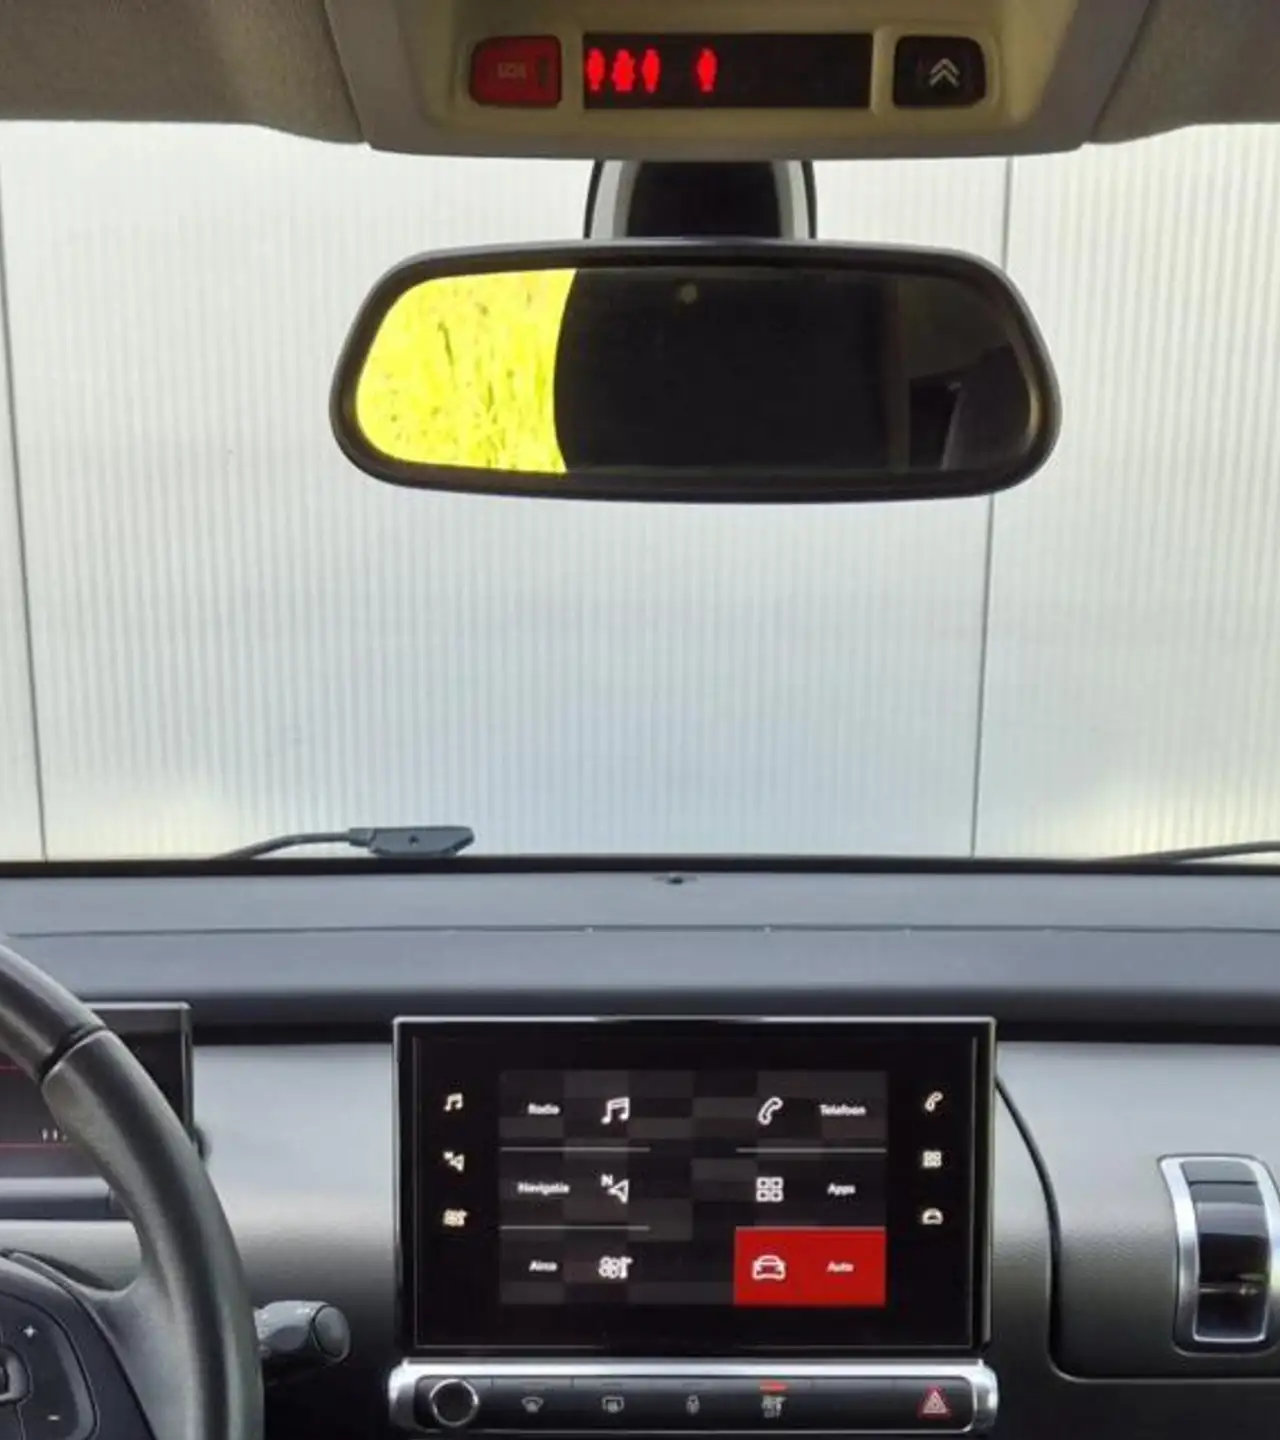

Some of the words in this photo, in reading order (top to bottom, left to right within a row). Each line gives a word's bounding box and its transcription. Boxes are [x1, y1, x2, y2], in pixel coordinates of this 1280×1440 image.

[820, 1104, 867, 1117] Telefoon
[827, 1183, 855, 1196] Apps
[827, 1260, 854, 1273] Auto
